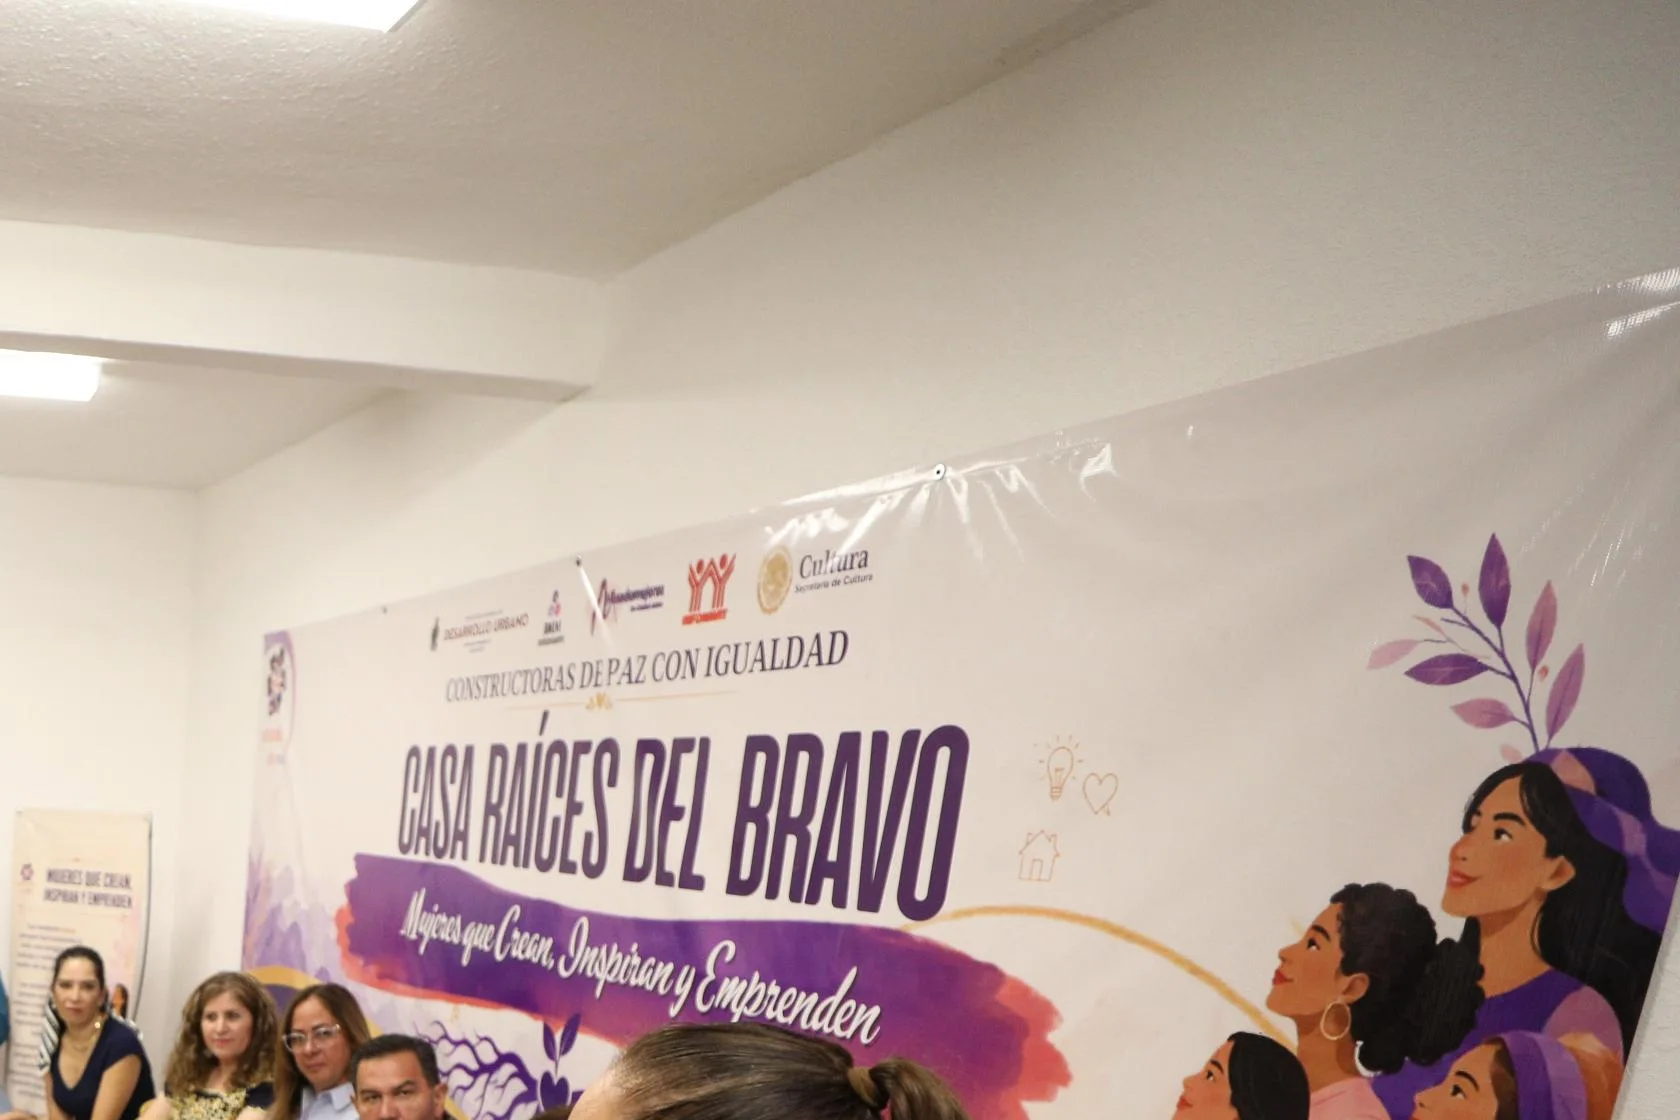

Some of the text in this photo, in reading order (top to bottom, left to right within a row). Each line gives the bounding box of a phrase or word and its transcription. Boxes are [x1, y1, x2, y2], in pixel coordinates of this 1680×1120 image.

[800, 549, 869, 579] Cultura
[446, 629, 849, 702] CONSTRUCTORAS DE PAZ CON IGUALDAD
[398, 711, 971, 921] CASA RAÍCES DEL BRAVO
[400, 888, 882, 1045] Mujeres que Crean, Inspiran y Emprenden
